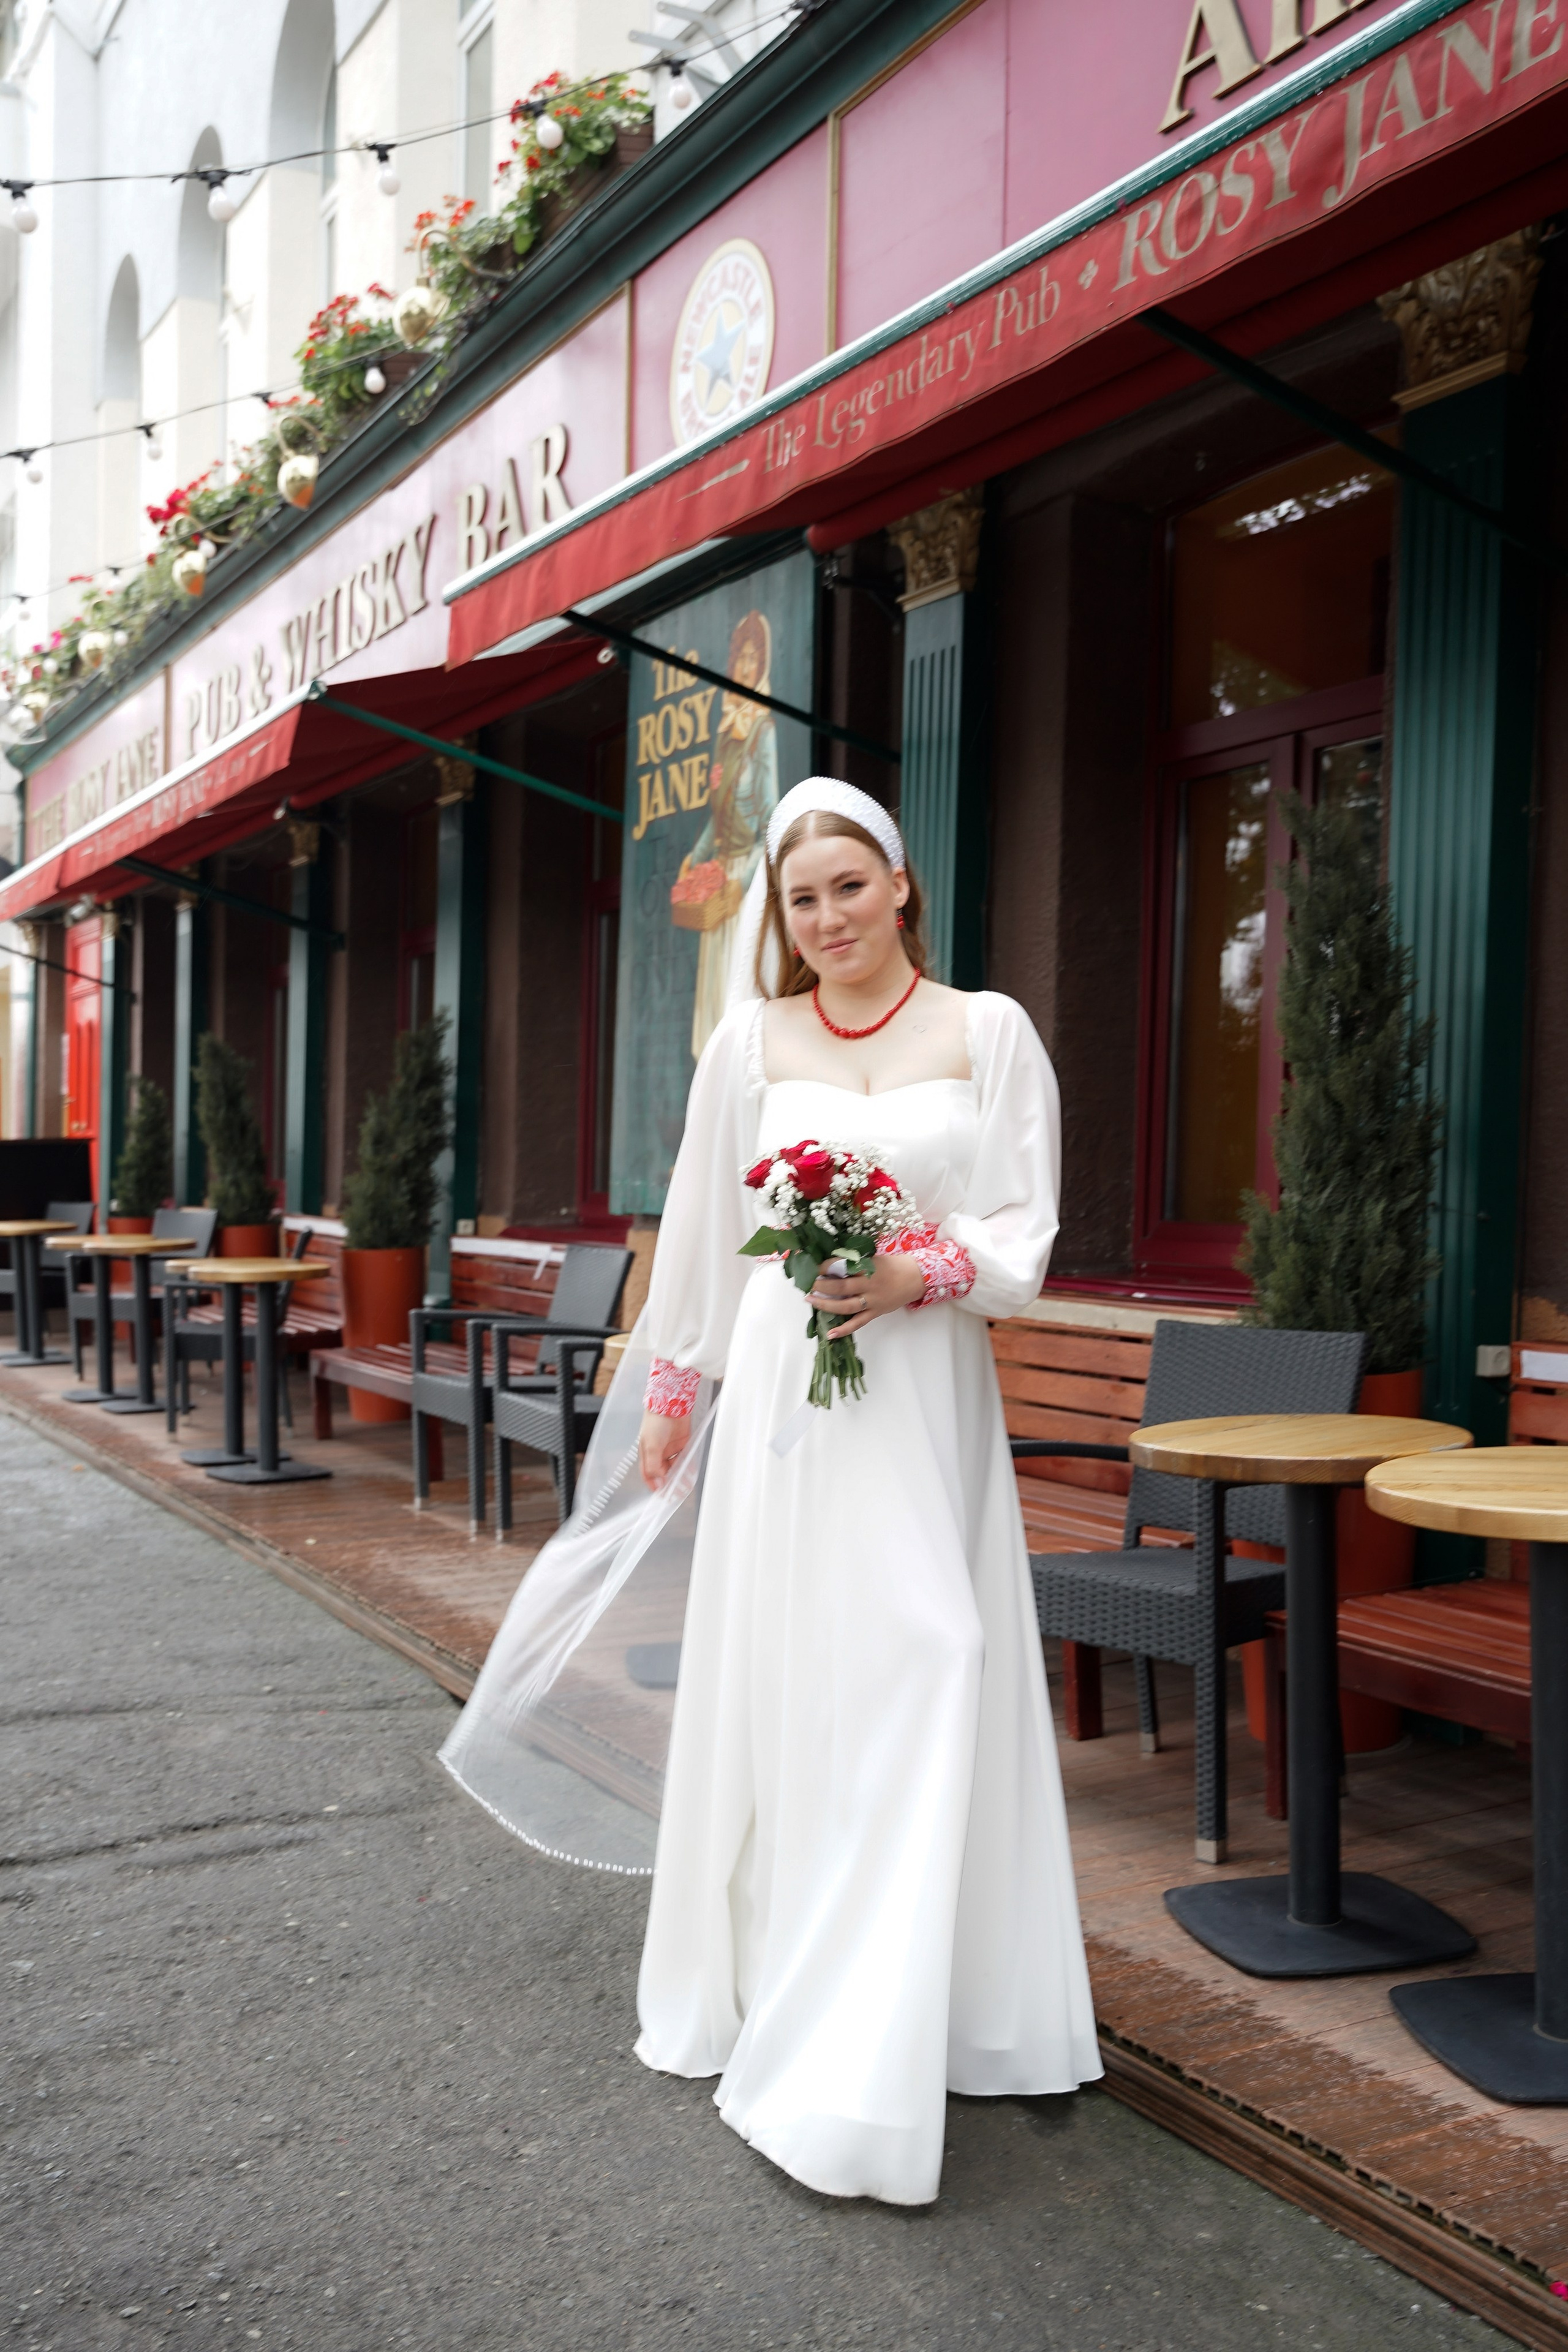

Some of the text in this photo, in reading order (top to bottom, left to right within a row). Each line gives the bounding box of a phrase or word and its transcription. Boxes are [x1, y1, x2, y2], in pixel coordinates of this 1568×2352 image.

[761, 419, 805, 474] The
[813, 320, 985, 449] Legendary
[988, 268, 1060, 350] Pub
[1112, 105, 1320, 293] ROSY
[1322, 0, 1566, 210] JANE
[185, 665, 241, 757] PUB
[279, 513, 438, 687] WHISKY
[456, 423, 575, 572] BAR
[633, 752, 710, 841] JANE
[636, 687, 717, 767] ROSY
